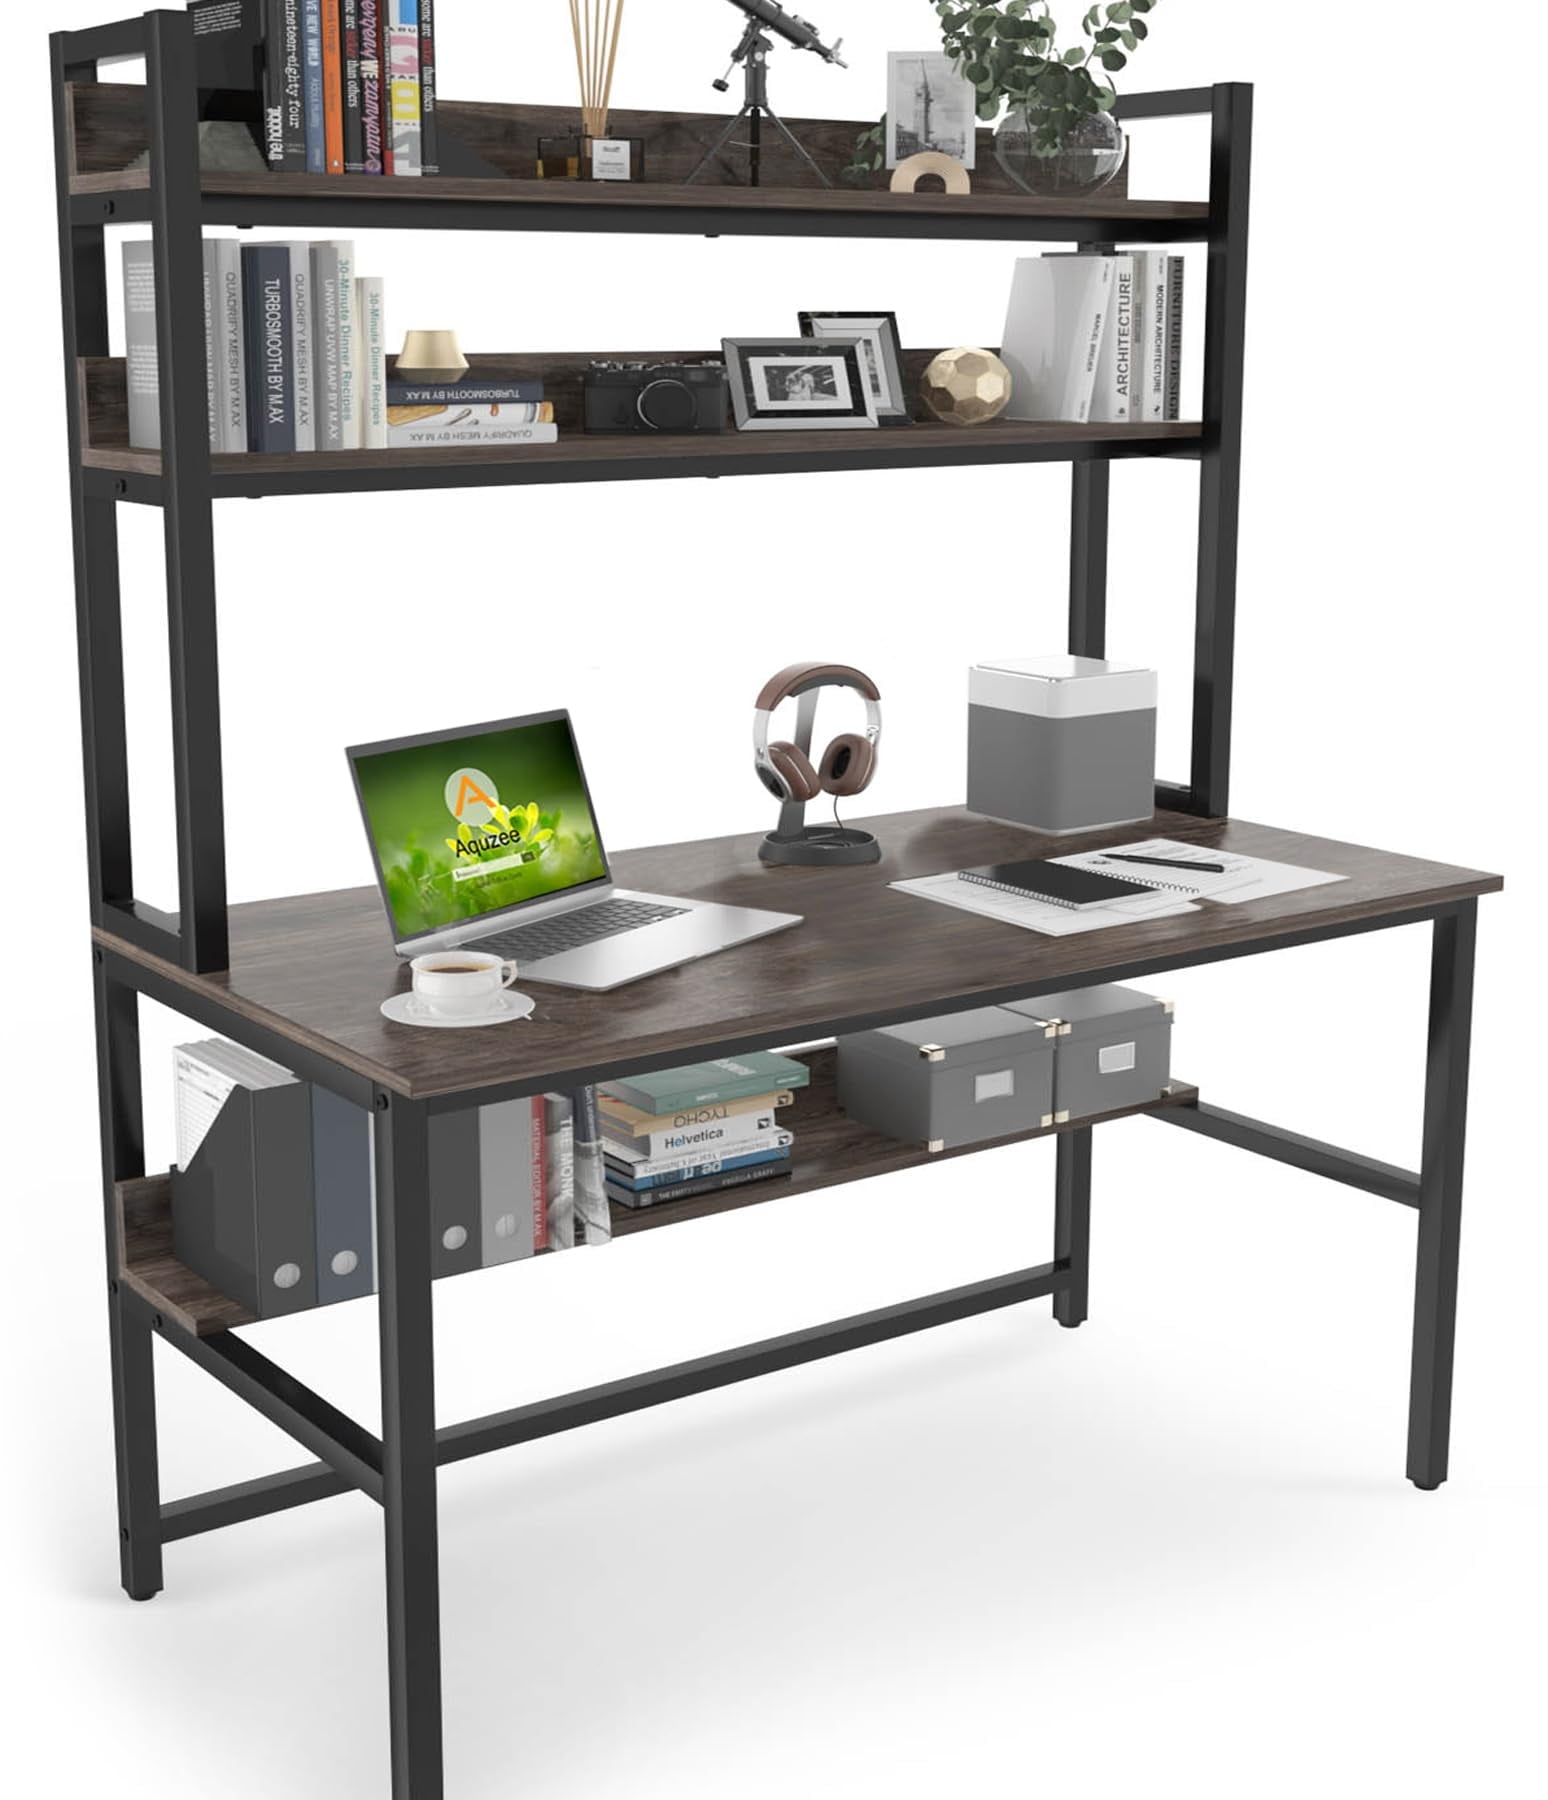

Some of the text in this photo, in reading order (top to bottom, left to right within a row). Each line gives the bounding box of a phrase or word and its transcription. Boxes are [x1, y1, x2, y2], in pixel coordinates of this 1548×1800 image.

[306, 14, 319, 35] NEW
[307, 38, 320, 67] WORLD
[347, 60, 360, 79] than
[361, 60, 378, 80] WE
[423, 66, 436, 85] than
[347, 80, 360, 108] others
[423, 86, 436, 113] others
[287, 99, 301, 129] four
[225, 271, 238, 337] QUADRIFY
[295, 273, 307, 337] QUADRIFY
[324, 279, 336, 332] UNWRAP
[1154, 284, 1165, 325] MODERN
[264, 278, 284, 373] TURBOSMOOTH
[1116, 272, 1131, 397] ARCHITECTURE
[338, 259, 353, 422] 30-Minute Dinner Recipes
[228, 339, 239, 375] MESH
[296, 339, 308, 375] MESH
[368, 292, 382, 426] 30-Minute Dinner Recipes
[1152, 326, 1163, 394] ARCHITECTURE
[229, 377, 240, 395] BY
[267, 376, 284, 392] BY
[297, 377, 309, 394] BY
[327, 365, 337, 390] MAP
[328, 392, 338, 410] BY
[432, 391, 445, 399] BY
[446, 389, 520, 399] TURBOSMOOTH
[437, 431, 451, 441] BY
[452, 431, 481, 441] MESH
[483, 430, 533, 440] QUADRIFY
[455, 829, 521, 858] Aquzee
[673, 1105, 730, 1128] TYCHO
[665, 1128, 723, 1149] Helvetica
[559, 1115, 574, 1202] THE MONK
